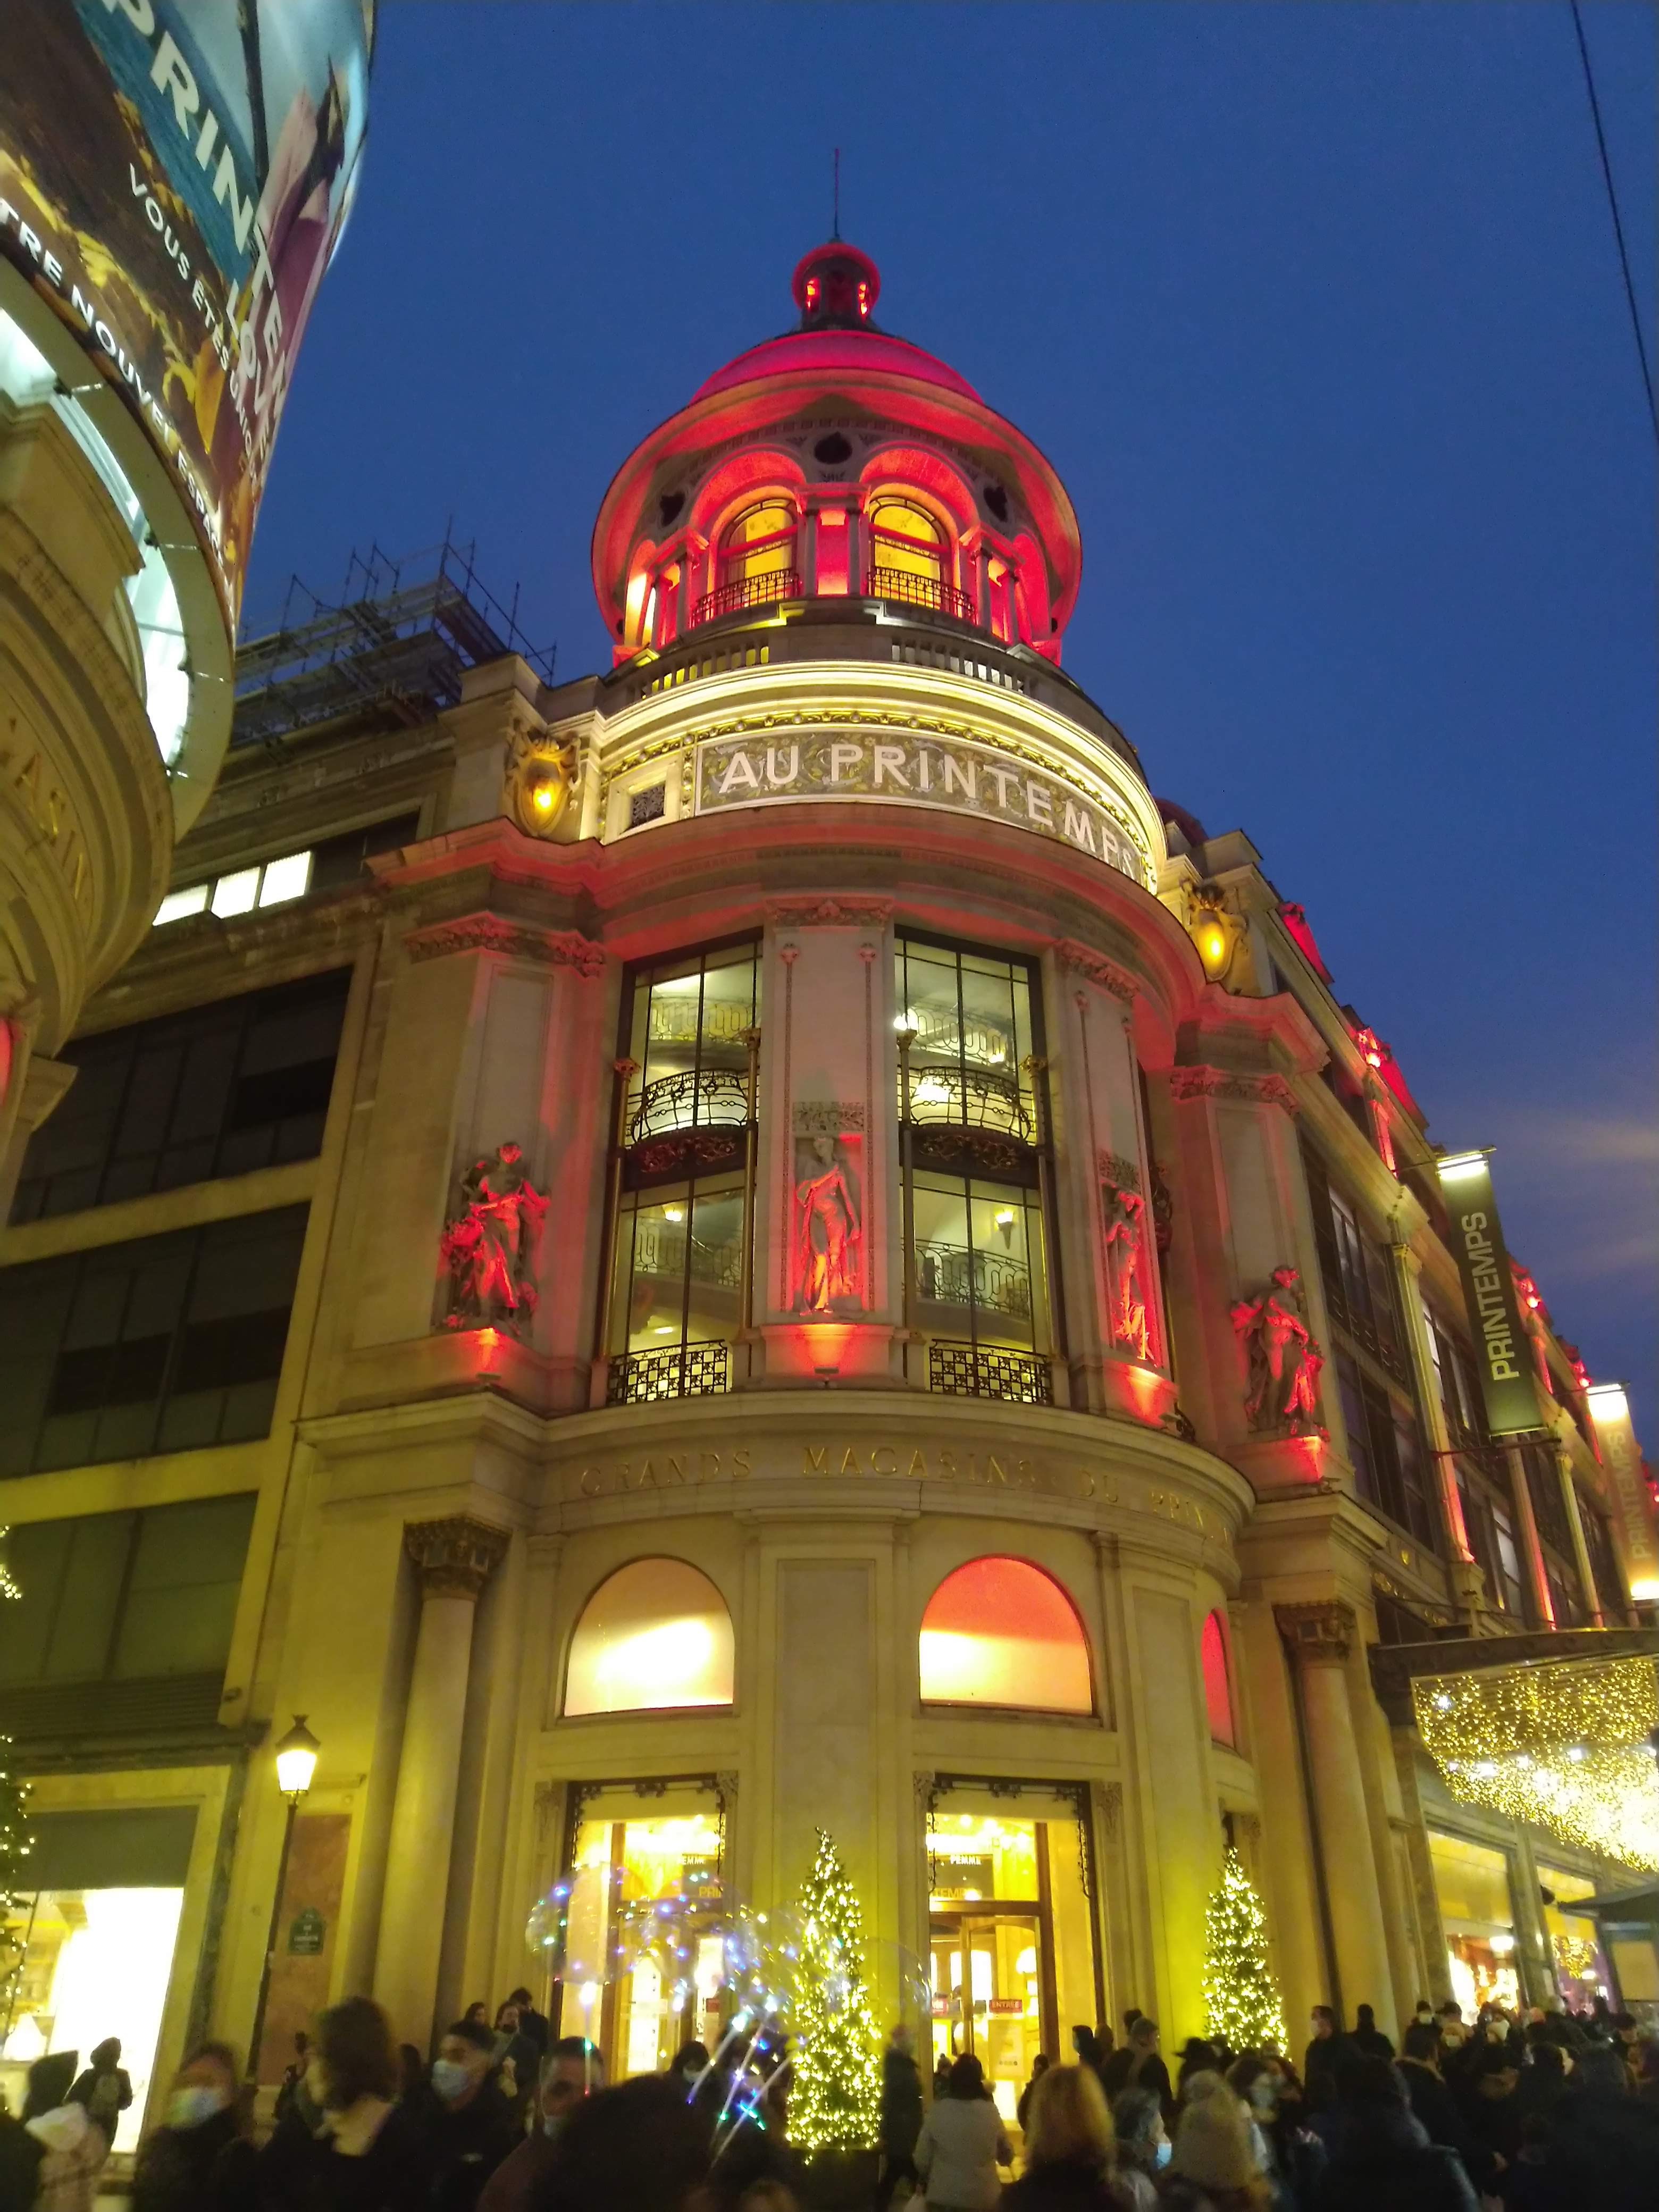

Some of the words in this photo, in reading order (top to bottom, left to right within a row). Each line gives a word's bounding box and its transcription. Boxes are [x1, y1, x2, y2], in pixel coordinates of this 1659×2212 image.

[130, 162, 190, 280] VOUS
[72, 284, 173, 456] NOUVEL
[719, 745, 799, 794] AU
[831, 744, 1134, 880] PRINTEMPS
[1462, 1212, 1520, 1380] PRINTEMPS
[580, 1449, 751, 1496] GRANDS
[803, 1446, 1036, 1485] MAGASINS
[1606, 1431, 1652, 1560] PRINTEMPS
